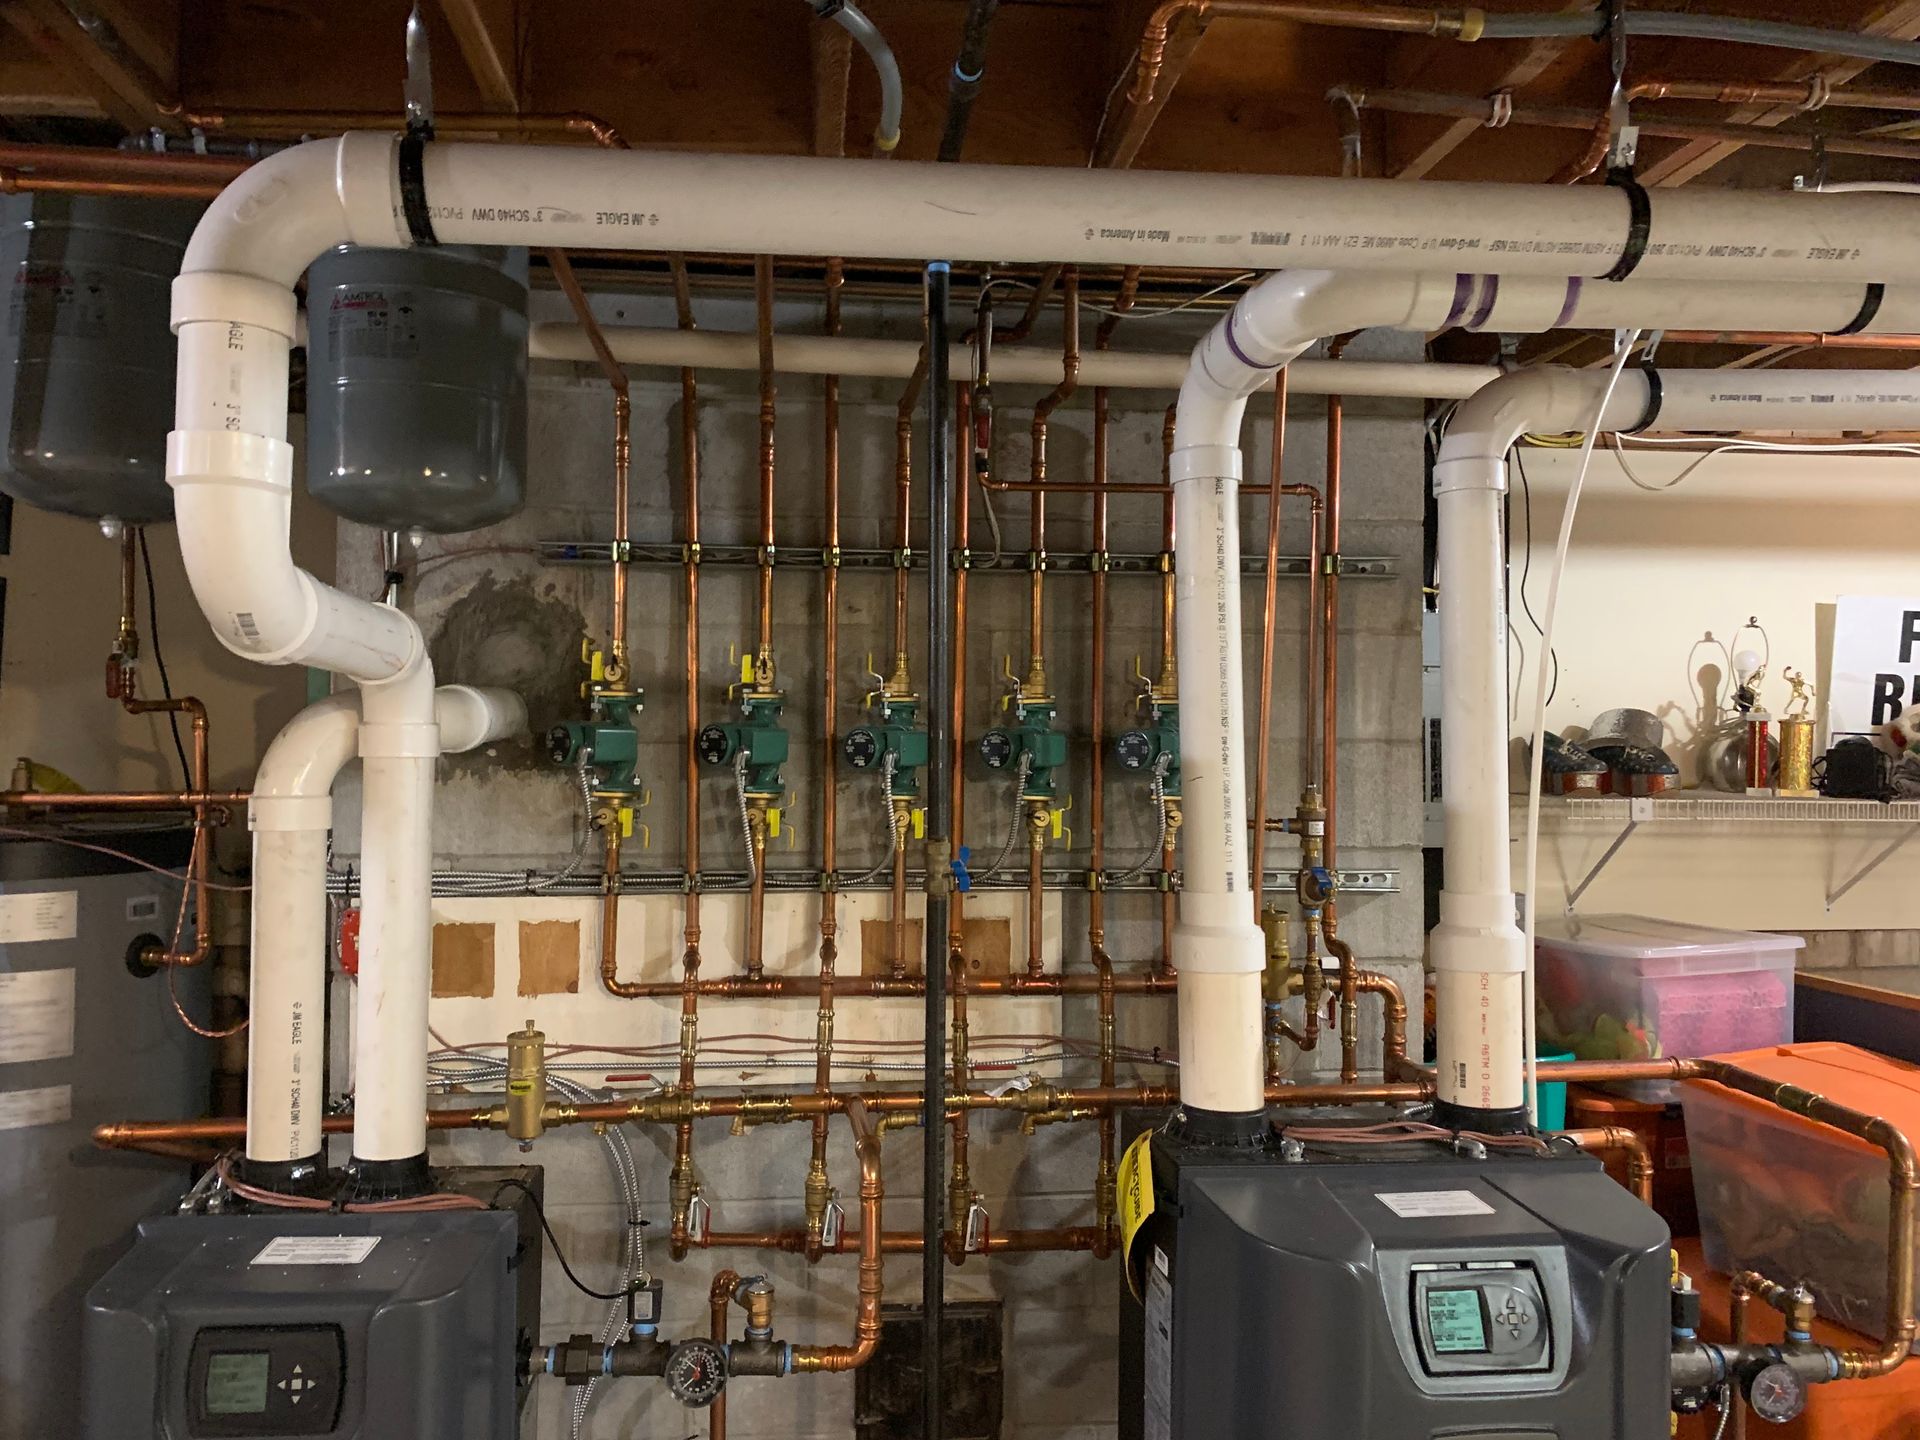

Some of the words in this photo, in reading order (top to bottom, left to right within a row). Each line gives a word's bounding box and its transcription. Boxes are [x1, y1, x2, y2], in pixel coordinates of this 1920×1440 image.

[426, 207, 465, 220] PVC112
[472, 208, 496, 222] DWV
[498, 209, 530, 222] SCH40
[595, 213, 630, 226] EAGLE
[632, 213, 646, 226] JM
[1100, 229, 1137, 242] America
[1137, 230, 1146, 242] in
[1146, 230, 1171, 243] Made
[1399, 237, 1420, 249] Code
[1488, 239, 1509, 252] NSF
[1806, 248, 1838, 260] EAGLE
[228, 320, 244, 350] AGLE
[1215, 477, 1224, 496] AGLE
[1216, 535, 1225, 556] SCH40
[1217, 556, 1226, 571] DWV
[1218, 613, 1227, 625] PSI
[1221, 716, 1230, 729] NSF
[1223, 780, 1232, 795] Code
[1479, 972, 1489, 991] SCH
[1480, 996, 1490, 1008] 40
[292, 1011, 302, 1021] JM
[292, 1021, 302, 1045] EAGLE
[1481, 1043, 1491, 1068] ASTM
[1481, 1072, 1490, 1080] D
[290, 1087, 301, 1109] SCH40
[290, 1109, 301, 1126] DWV
